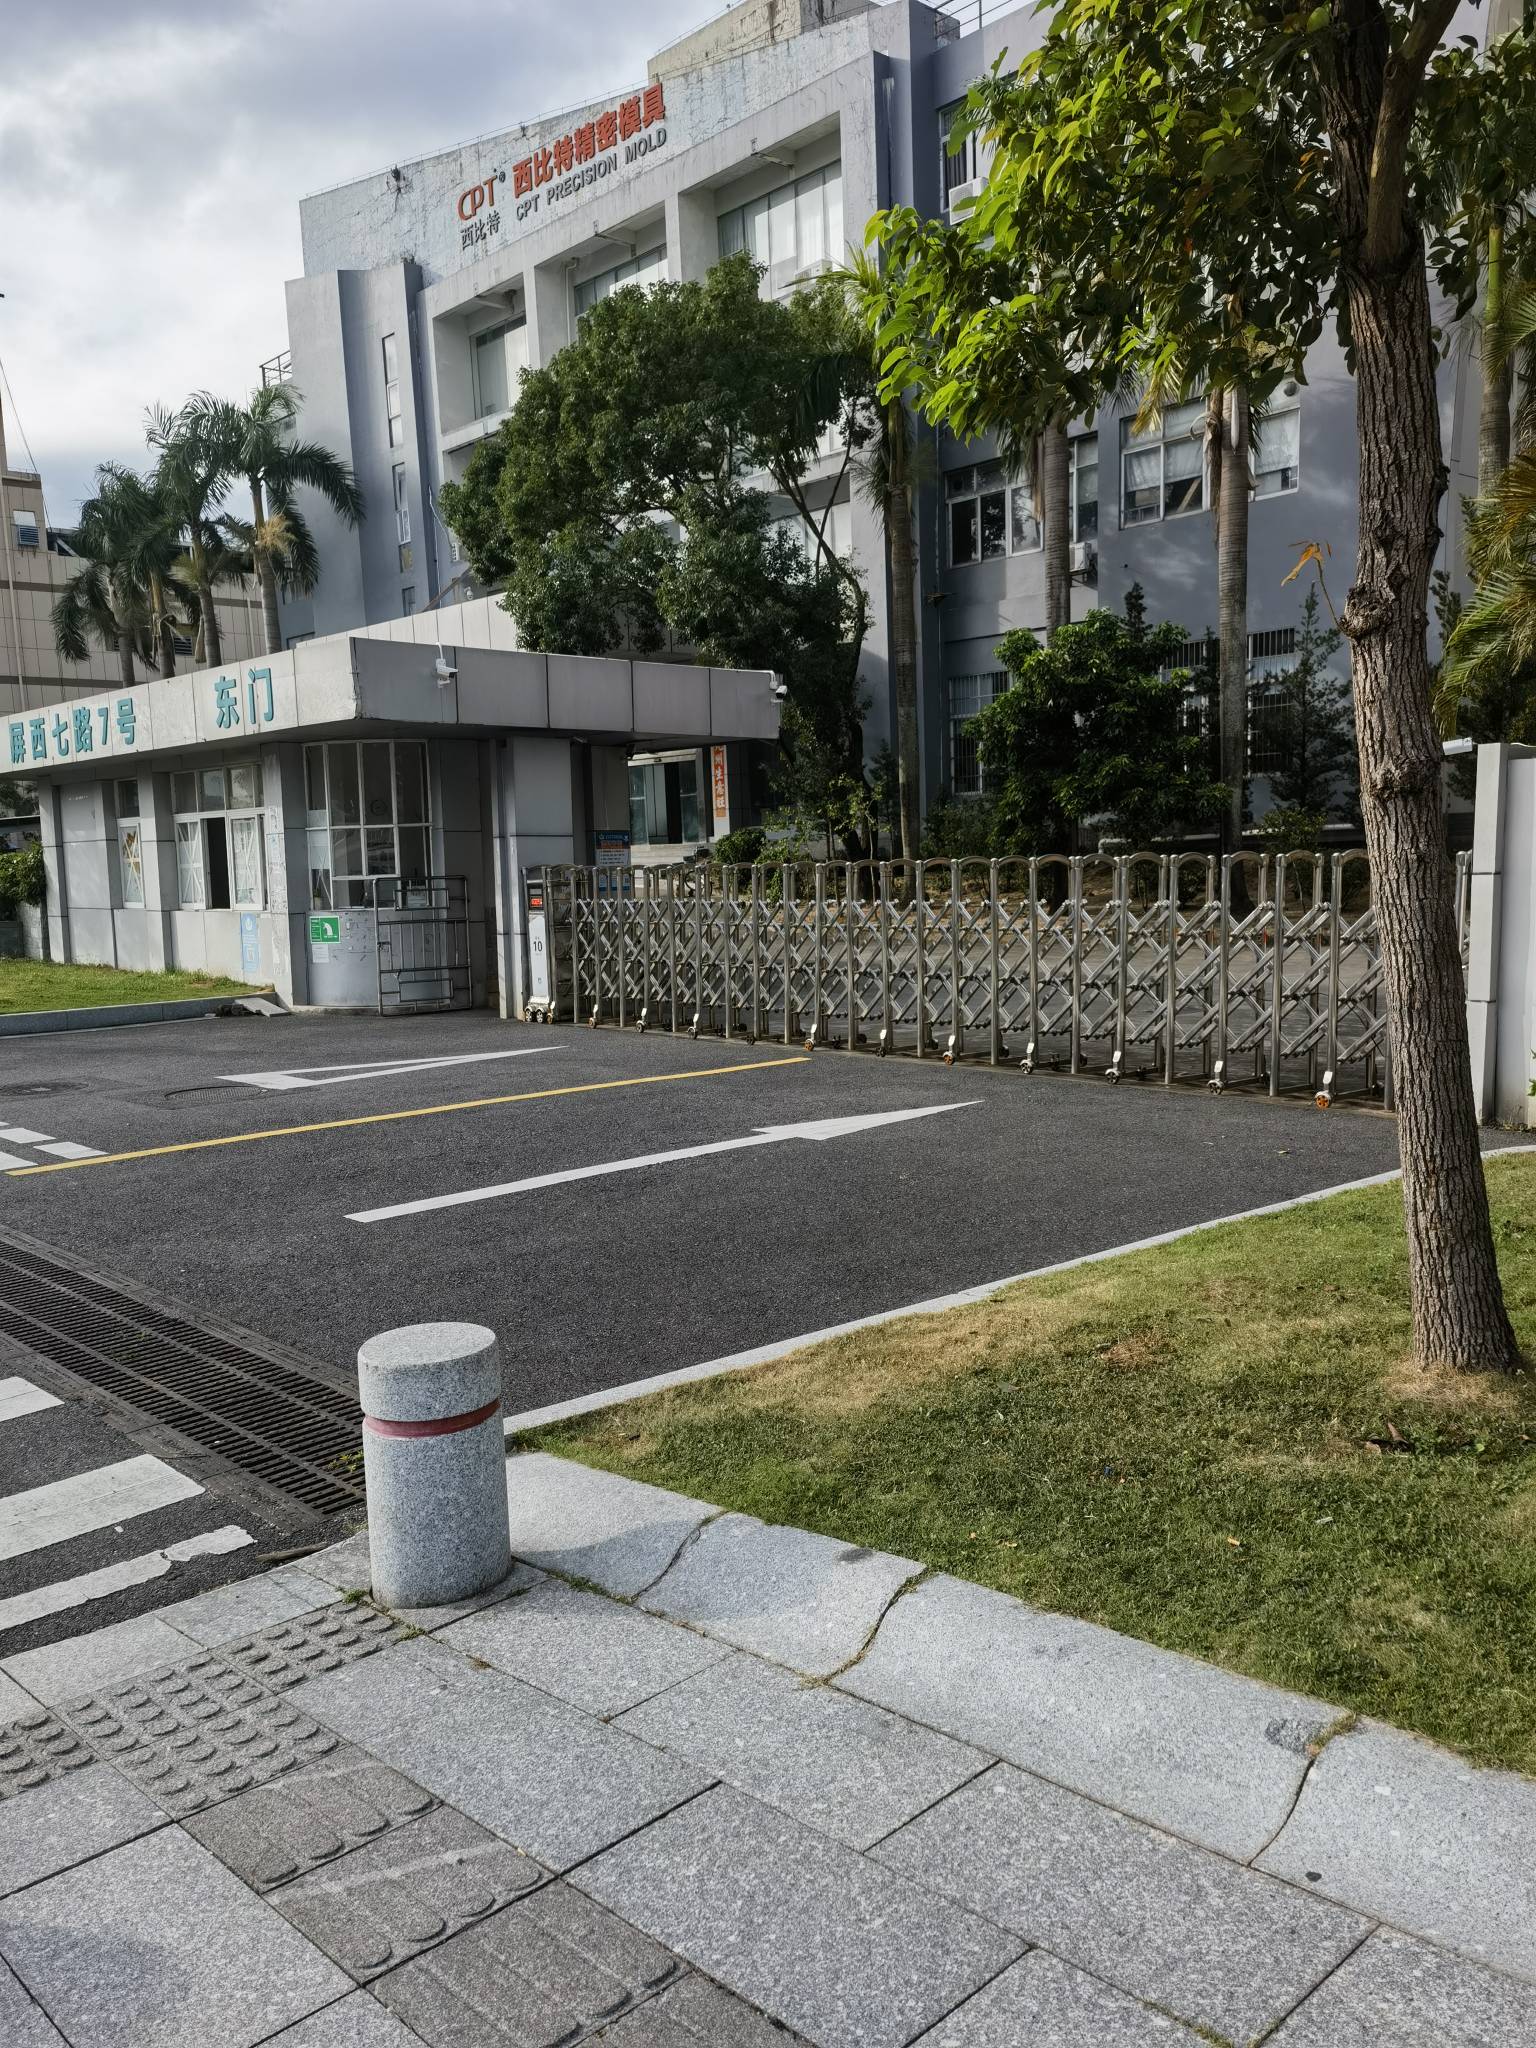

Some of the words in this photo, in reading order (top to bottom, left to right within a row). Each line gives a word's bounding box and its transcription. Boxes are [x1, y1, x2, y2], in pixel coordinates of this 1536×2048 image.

[512, 83, 665, 199] 西比特精密模具
[516, 194, 540, 222] CPT
[546, 153, 617, 205] PRECISION
[624, 127, 667, 166] MOLD
[460, 210, 500, 251] 西比特
[8, 697, 137, 764] 屏西七路7号
[214, 667, 275, 729] 东门
